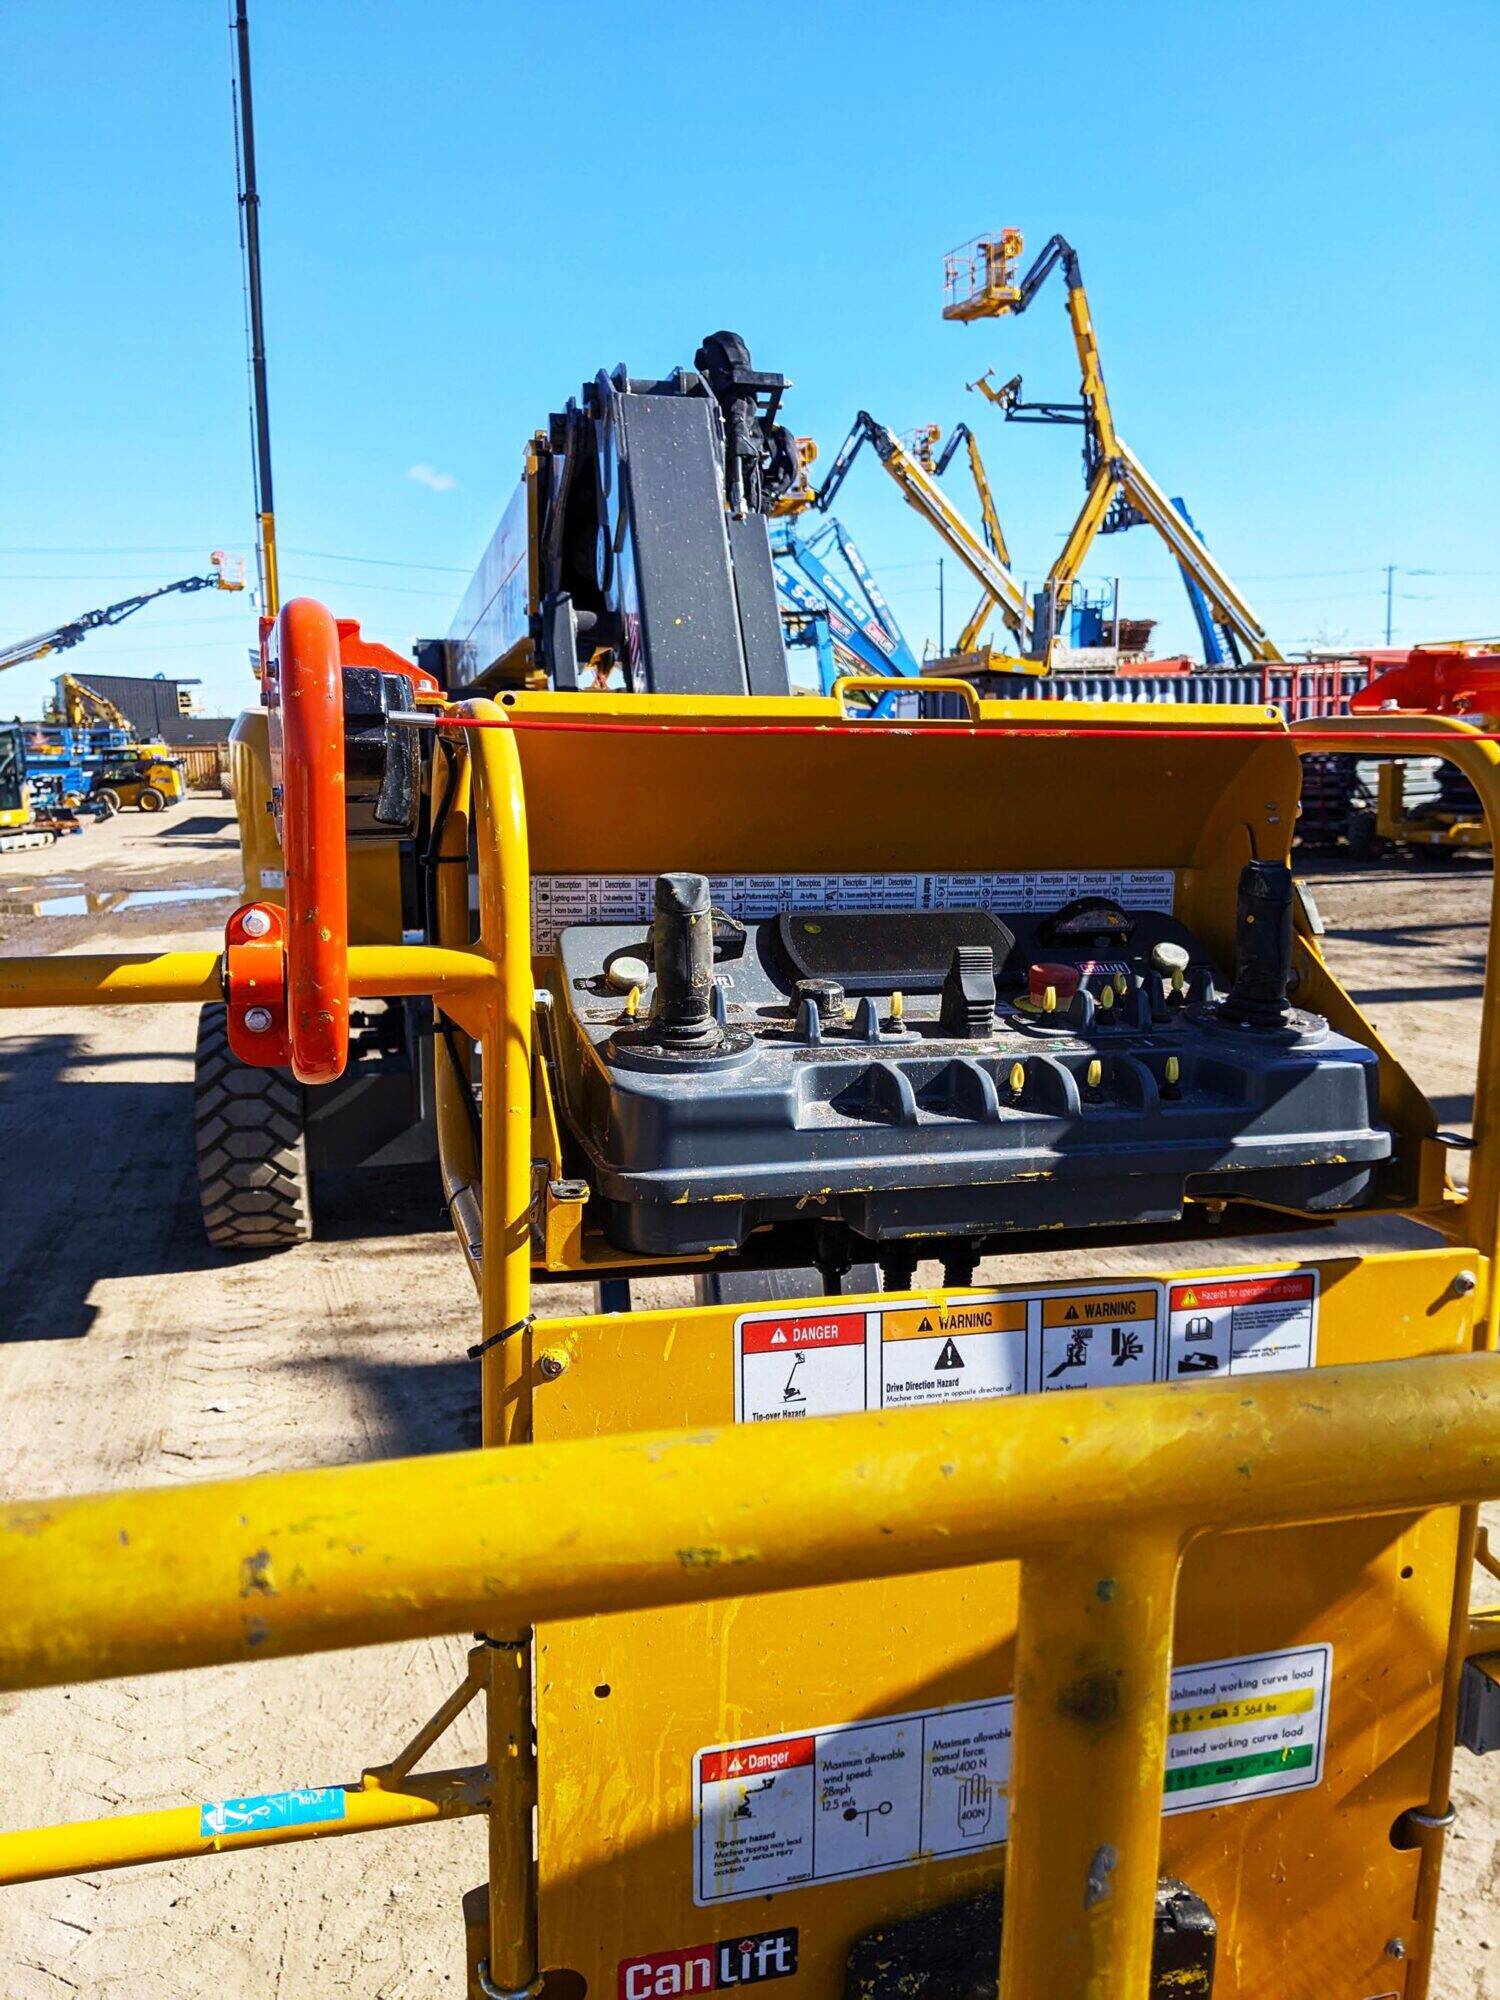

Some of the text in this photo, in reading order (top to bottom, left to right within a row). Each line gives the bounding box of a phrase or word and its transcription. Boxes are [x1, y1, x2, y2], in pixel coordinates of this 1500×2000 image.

[555, 880, 582, 889] Description
[605, 880, 631, 889] Description
[709, 879, 728, 888] scription
[750, 879, 775, 888] Description
[796, 878, 821, 888] Description
[842, 878, 867, 887] Description
[888, 877, 912, 886] Description
[952, 877, 976, 886] Description
[996, 876, 1020, 885] Description
[1040, 875, 1063, 884] Description
[1083, 875, 1106, 884] Description
[1130, 874, 1165, 883] Description
[551, 894, 586, 903] Lighting switch
[1201, 1290, 1227, 1301] Hazards
[1228, 1288, 1238, 1298] for
[1084, 1301, 1136, 1318] WARNING
[939, 1312, 993, 1330] WARNING
[793, 1325, 838, 1342] DANGER
[886, 1377, 959, 1393] Drive Direction Hazard
[886, 1394, 912, 1403] Machine
[951, 1389, 976, 1398] opposite
[978, 1385, 1004, 1394] direction
[752, 1408, 806, 1421] Tip-over Hazard
[1171, 1667, 1314, 1700] Unlimited working curve load
[1244, 1702, 1277, 1717] 564 lbs
[931, 1728, 1012, 1751] Maximum allowable
[1171, 1726, 1304, 1759] Limited working curve load
[748, 1751, 790, 1769] Danger
[822, 1748, 906, 1772] Maximum allowable
[931, 1751, 961, 1763] manual
[931, 1758, 988, 1777] 90lbs/400 N
[823, 1769, 873, 1785] wind speed:
[822, 1785, 851, 1799] 28mph
[822, 1798, 857, 1812] 12.5 m/s
[961, 1807, 985, 1820] 400N
[715, 1831, 776, 1849] Tip-over hazard
[745, 1844, 769, 1856] tipping
[770, 1840, 785, 1850] may
[786, 1837, 802, 1847] lead
[751, 1852, 775, 1862] serious
[776, 1847, 794, 1858] injury
